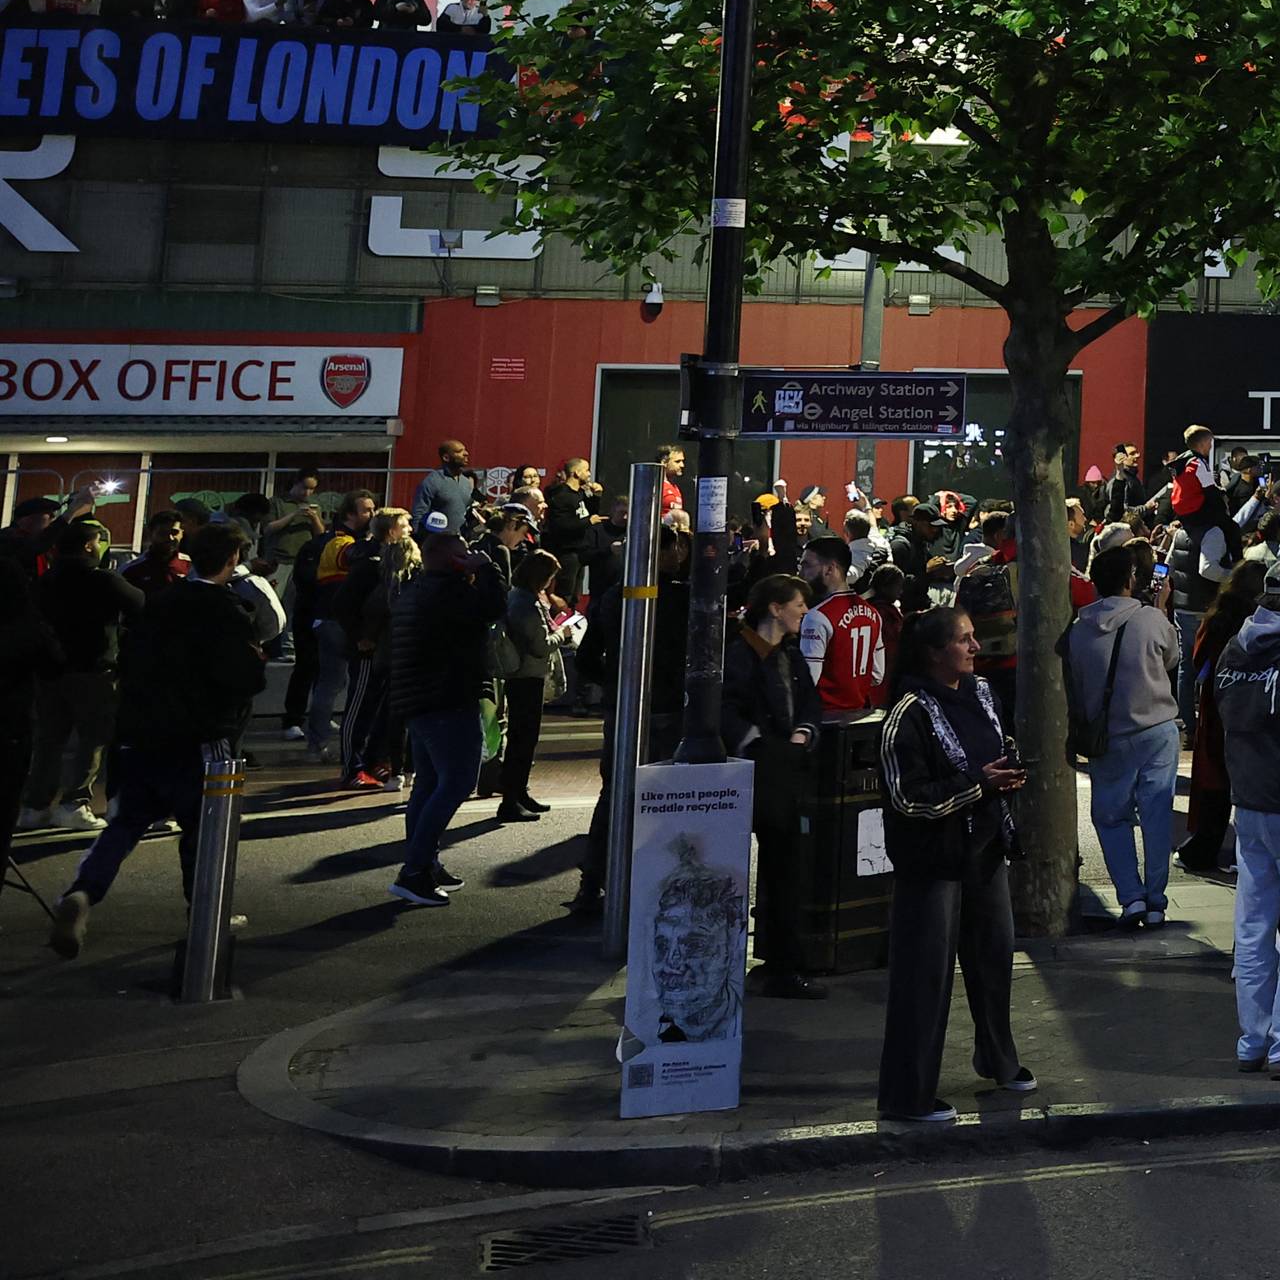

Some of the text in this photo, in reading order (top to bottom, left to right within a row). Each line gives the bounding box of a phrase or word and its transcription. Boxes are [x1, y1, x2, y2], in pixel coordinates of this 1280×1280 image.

[134, 32, 221, 120] OF
[227, 37, 488, 133] LONDON
[327, 361, 366, 373] Arsenal
[117, 359, 297, 402] OFFICE
[809, 382, 935, 398] Archway Station
[829, 405, 934, 420] Angel Station
[902, 422, 933, 430] Station
[838, 604, 877, 630] TORREIRA
[850, 625, 872, 678] 11
[641, 788, 740, 801] Like most people,
[640, 800, 738, 814] Freddie recycles.
